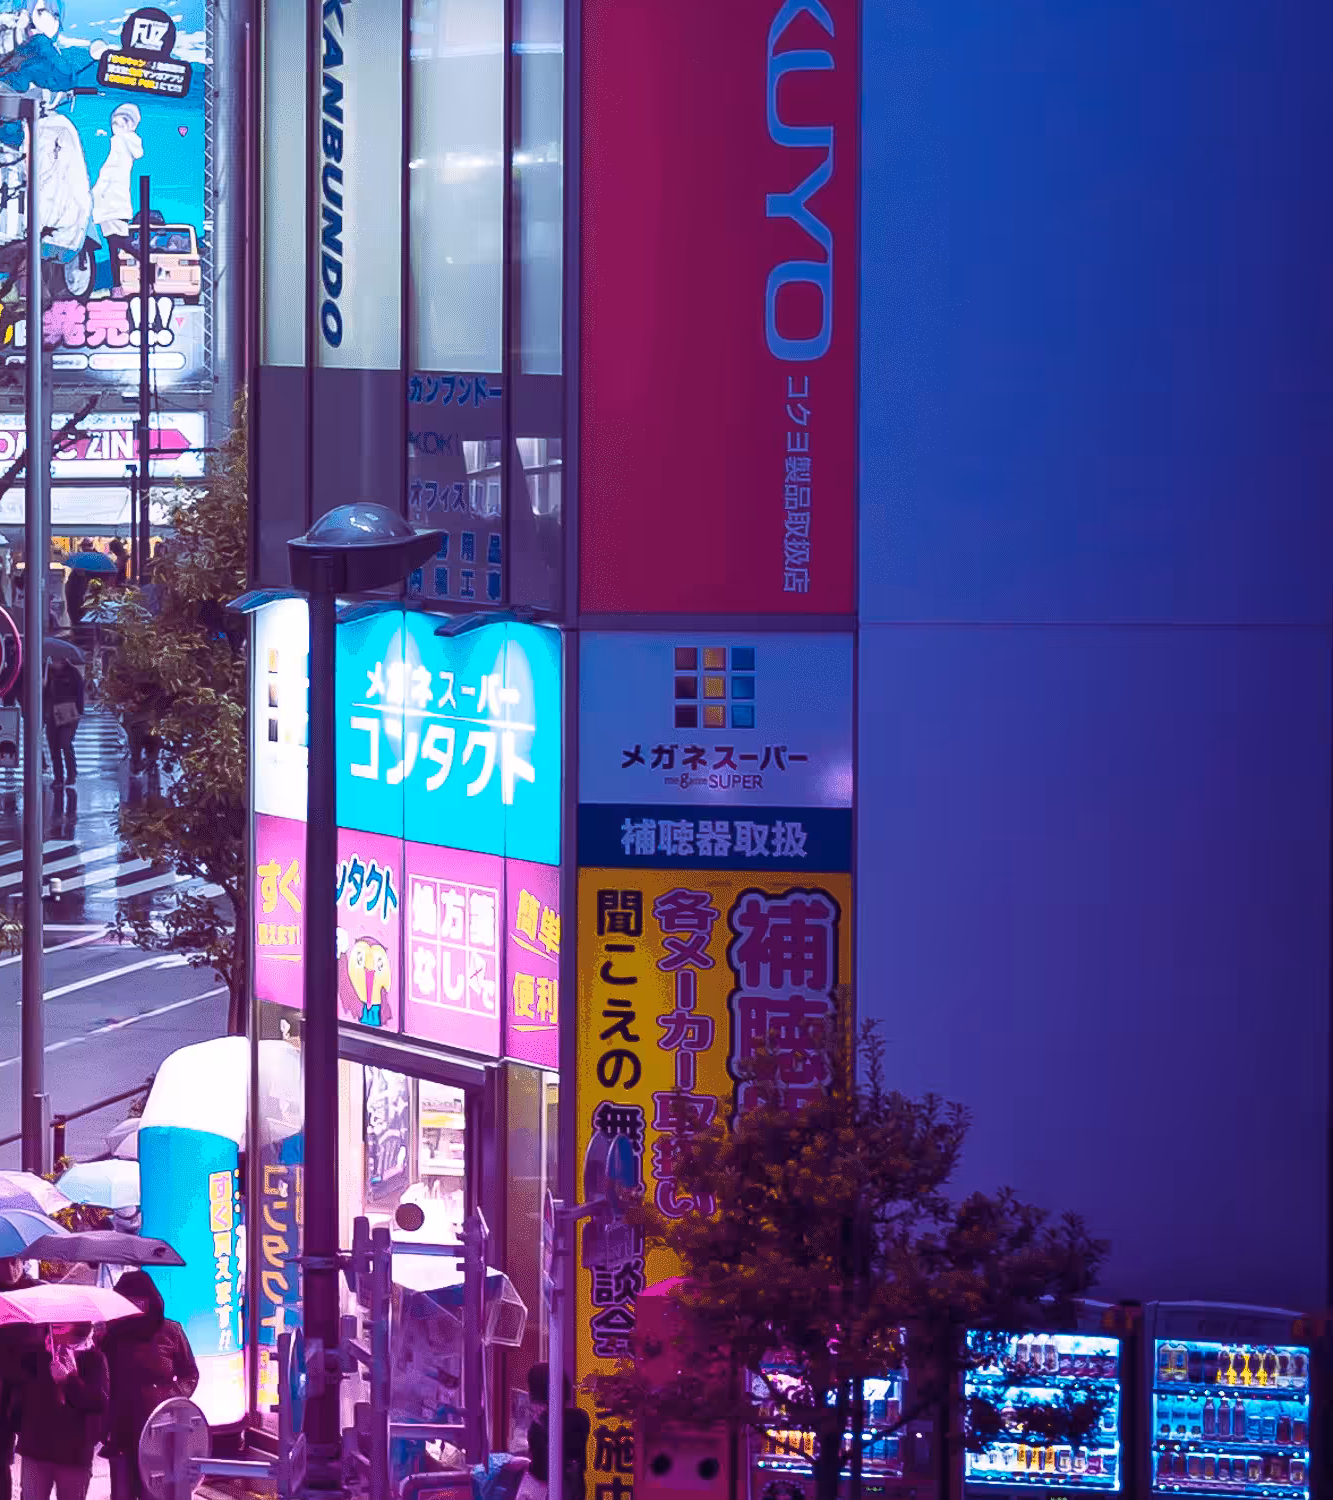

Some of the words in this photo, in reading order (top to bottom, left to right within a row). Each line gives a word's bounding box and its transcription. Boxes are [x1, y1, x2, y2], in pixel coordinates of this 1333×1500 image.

[365, 662, 522, 710] メガネスーパー
[349, 715, 536, 805] コンタクト
[621, 743, 809, 772] メガネスーパー
[621, 819, 808, 858] 補聴器取扱
[595, 889, 643, 1089] 聞こえの
